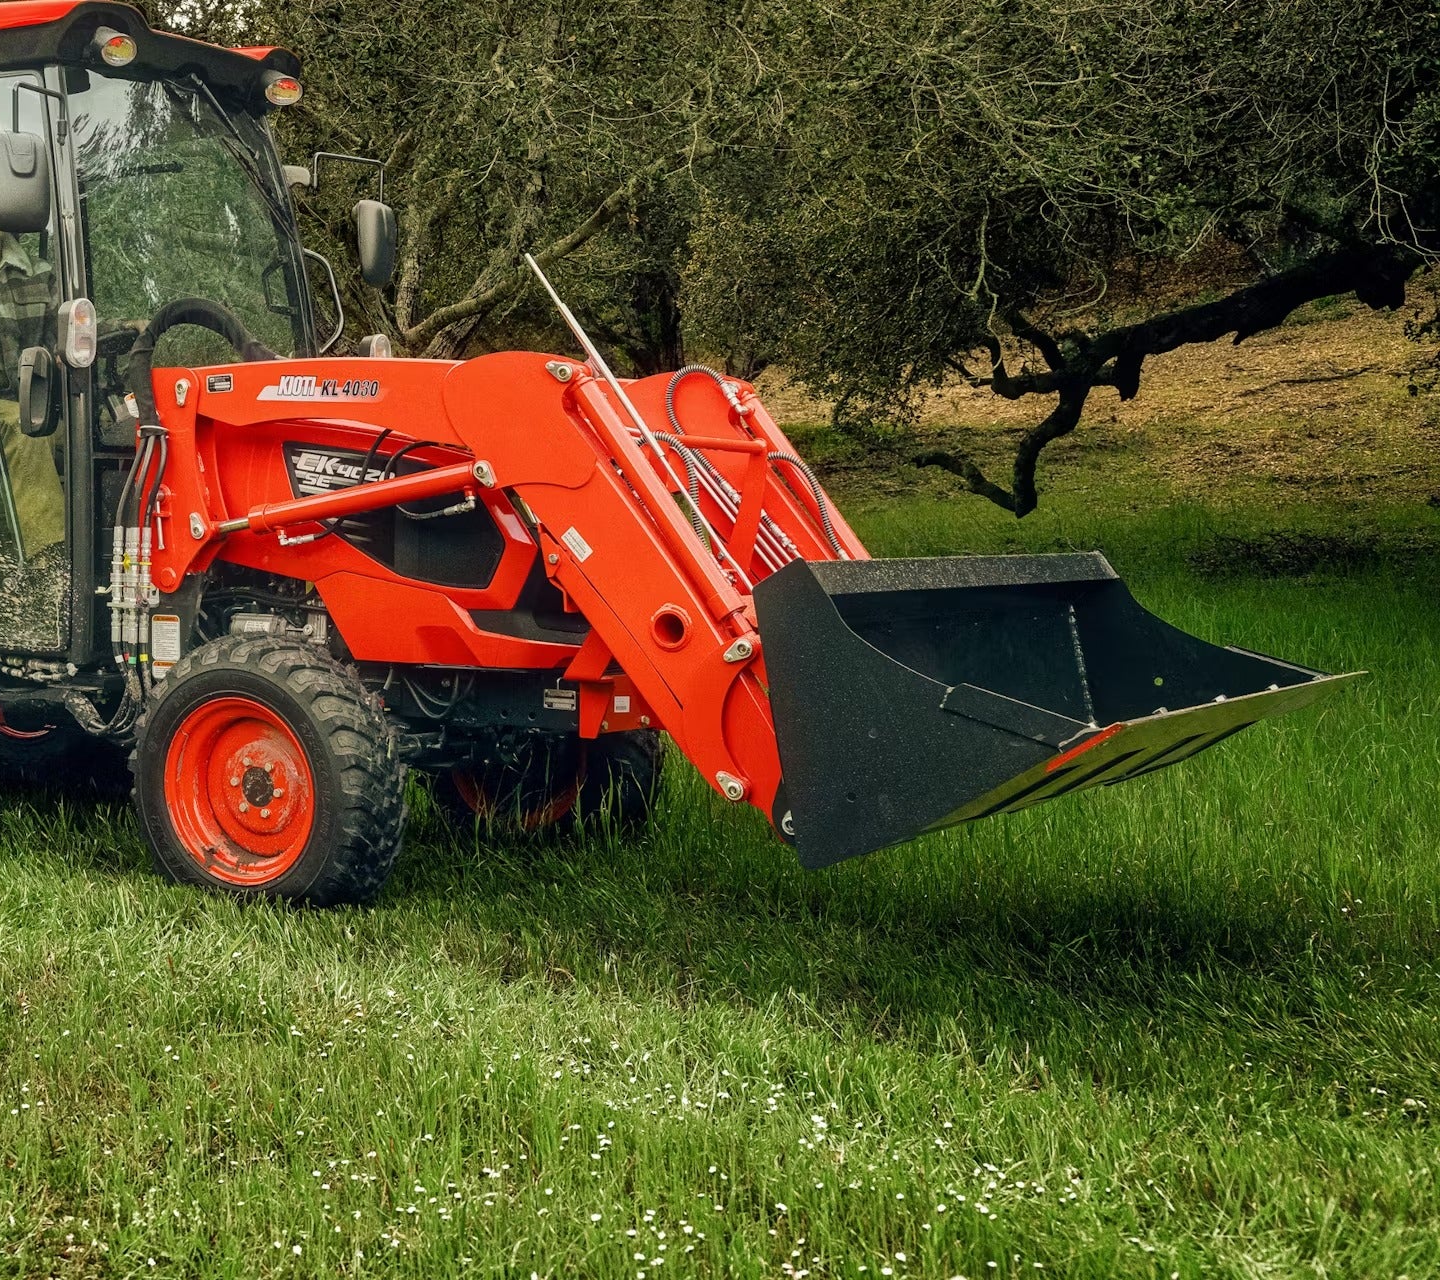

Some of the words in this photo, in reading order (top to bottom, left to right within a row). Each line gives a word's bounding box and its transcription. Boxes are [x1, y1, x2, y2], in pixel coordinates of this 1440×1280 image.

[277, 375, 318, 397] KIOTI
[320, 379, 339, 397] KL
[341, 379, 380, 397] 4030
[302, 473, 332, 488] SE
